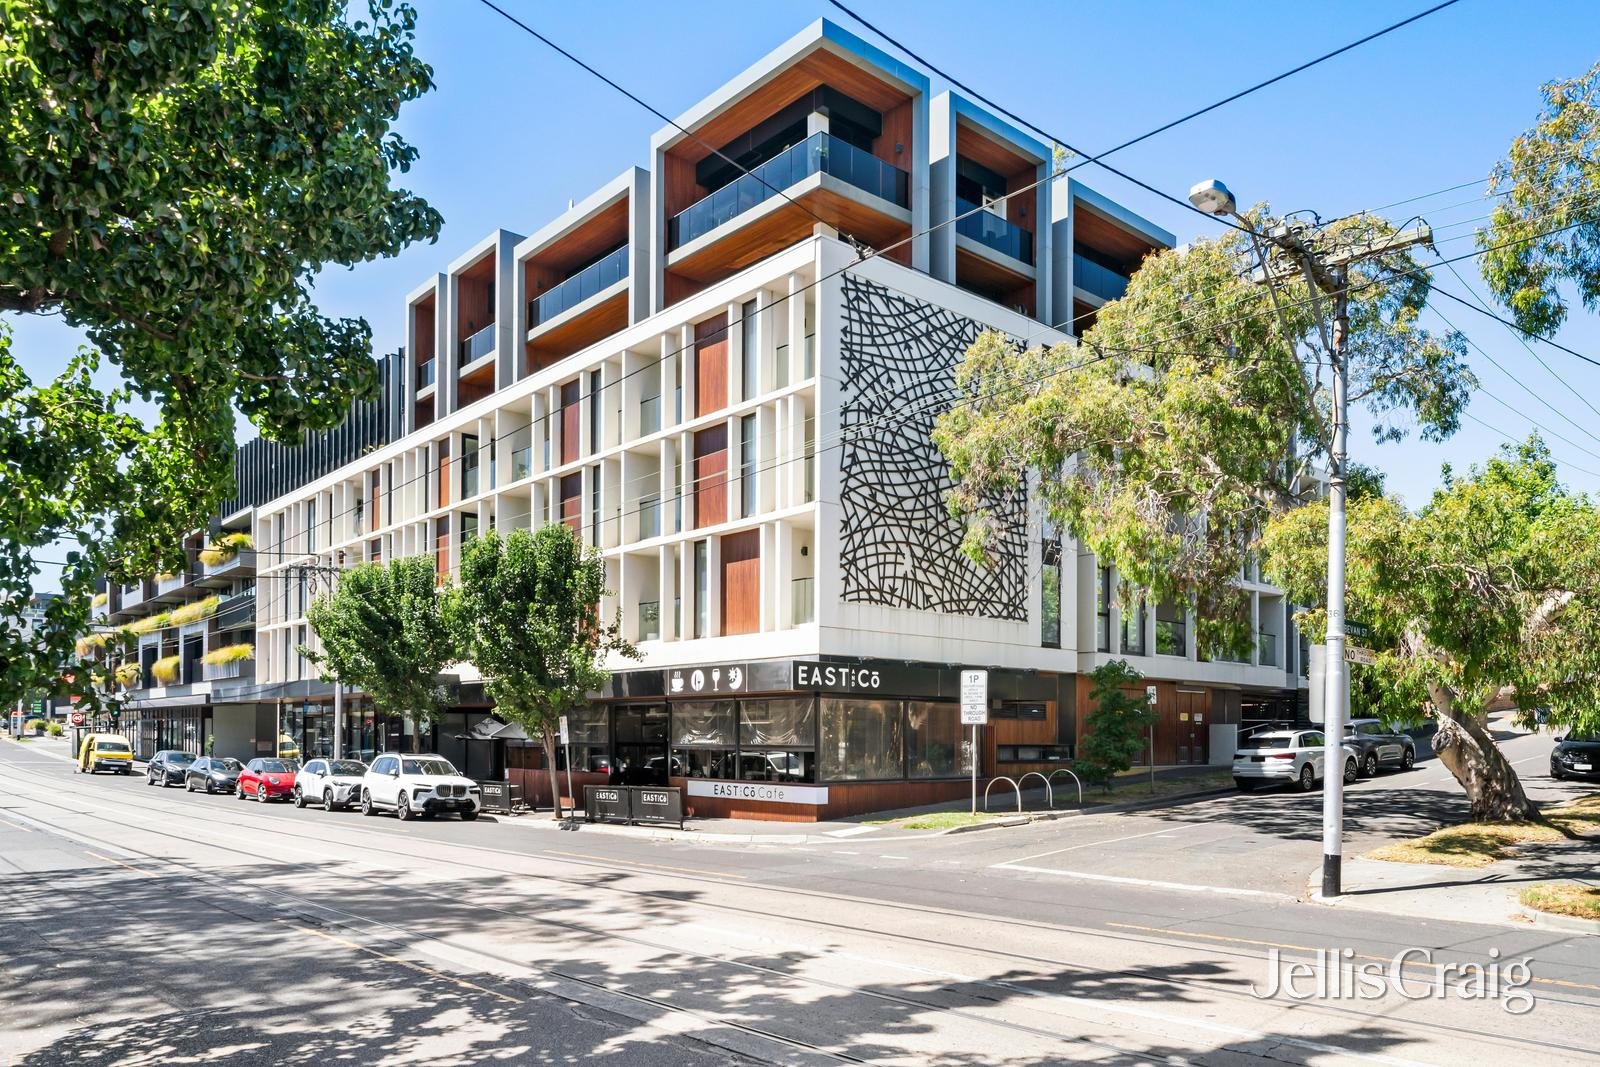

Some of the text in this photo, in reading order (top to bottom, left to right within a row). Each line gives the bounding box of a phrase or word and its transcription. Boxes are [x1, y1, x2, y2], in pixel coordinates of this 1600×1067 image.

[1344, 649, 1355, 660] NO
[798, 665, 849, 687] EAST
[969, 674, 979, 683] 1P
[713, 784, 738, 797] EAST
[643, 793, 657, 802] EAST
